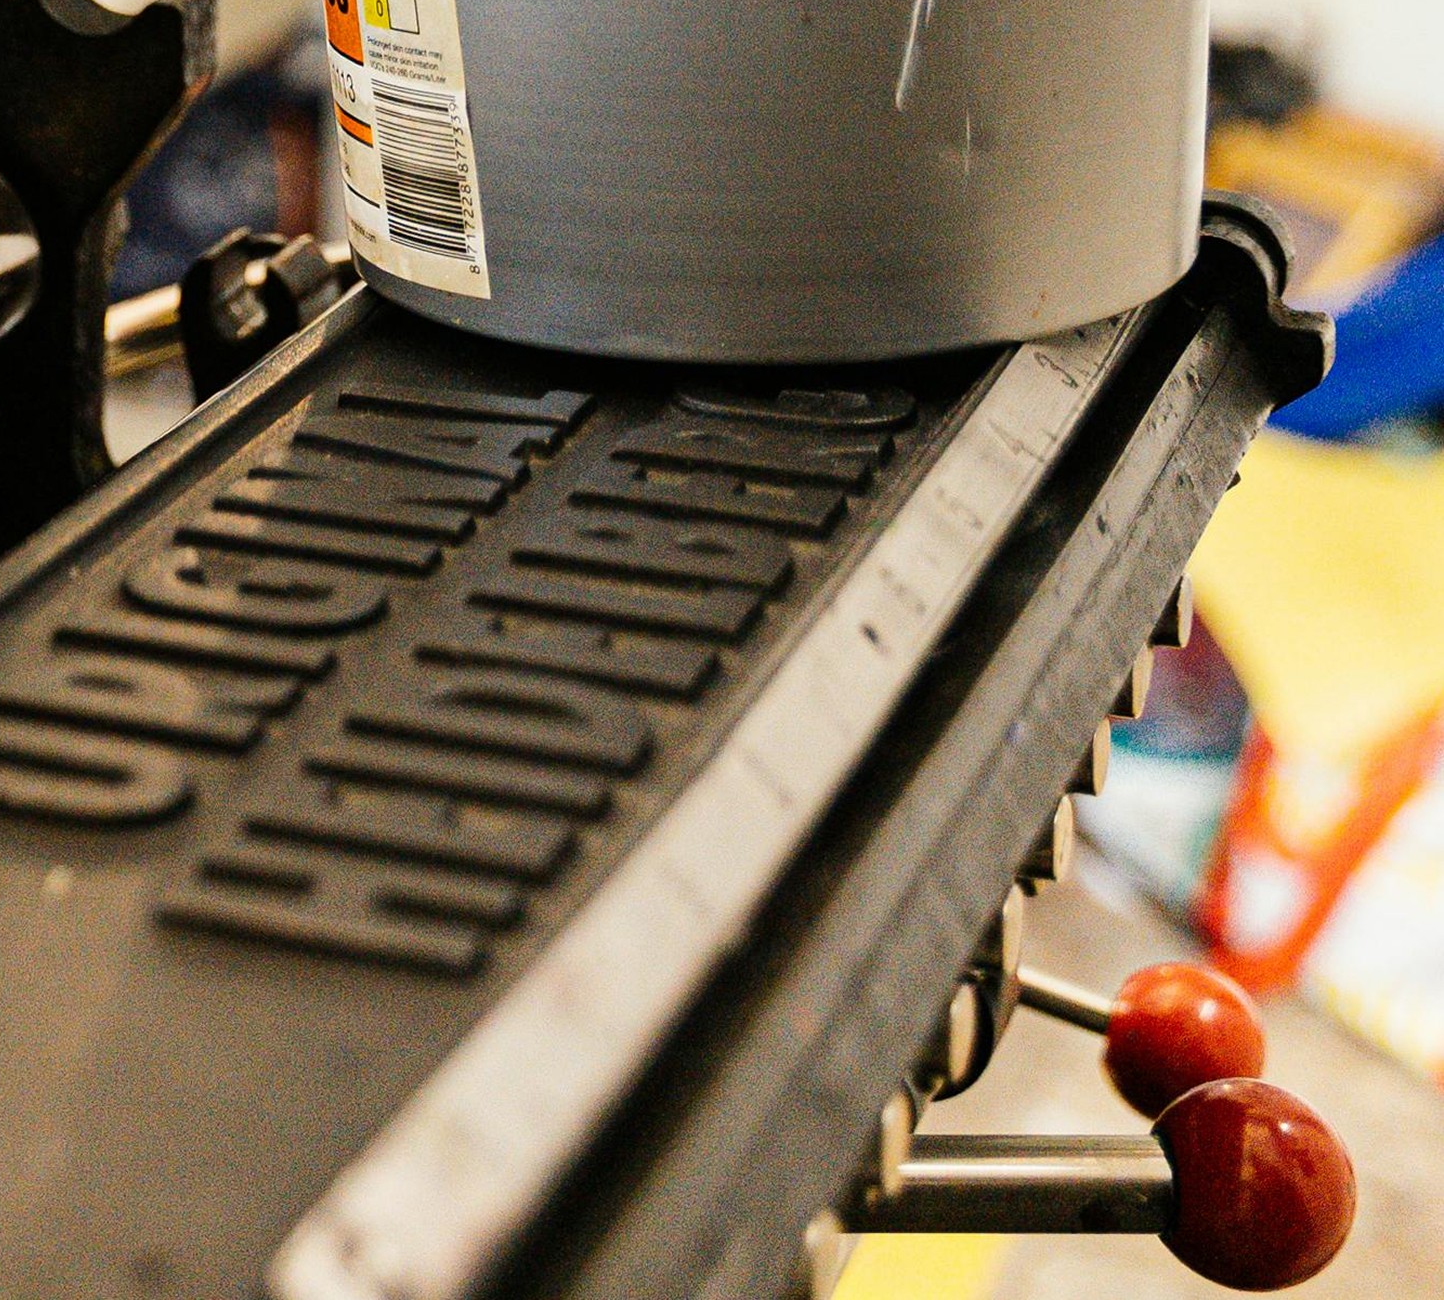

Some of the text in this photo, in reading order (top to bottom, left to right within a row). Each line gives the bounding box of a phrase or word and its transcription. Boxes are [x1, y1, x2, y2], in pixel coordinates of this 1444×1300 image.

[376, 0, 384, 17] 0
[404, 46, 427, 57] contact
[150, 380, 918, 980] HEIDELBERG
